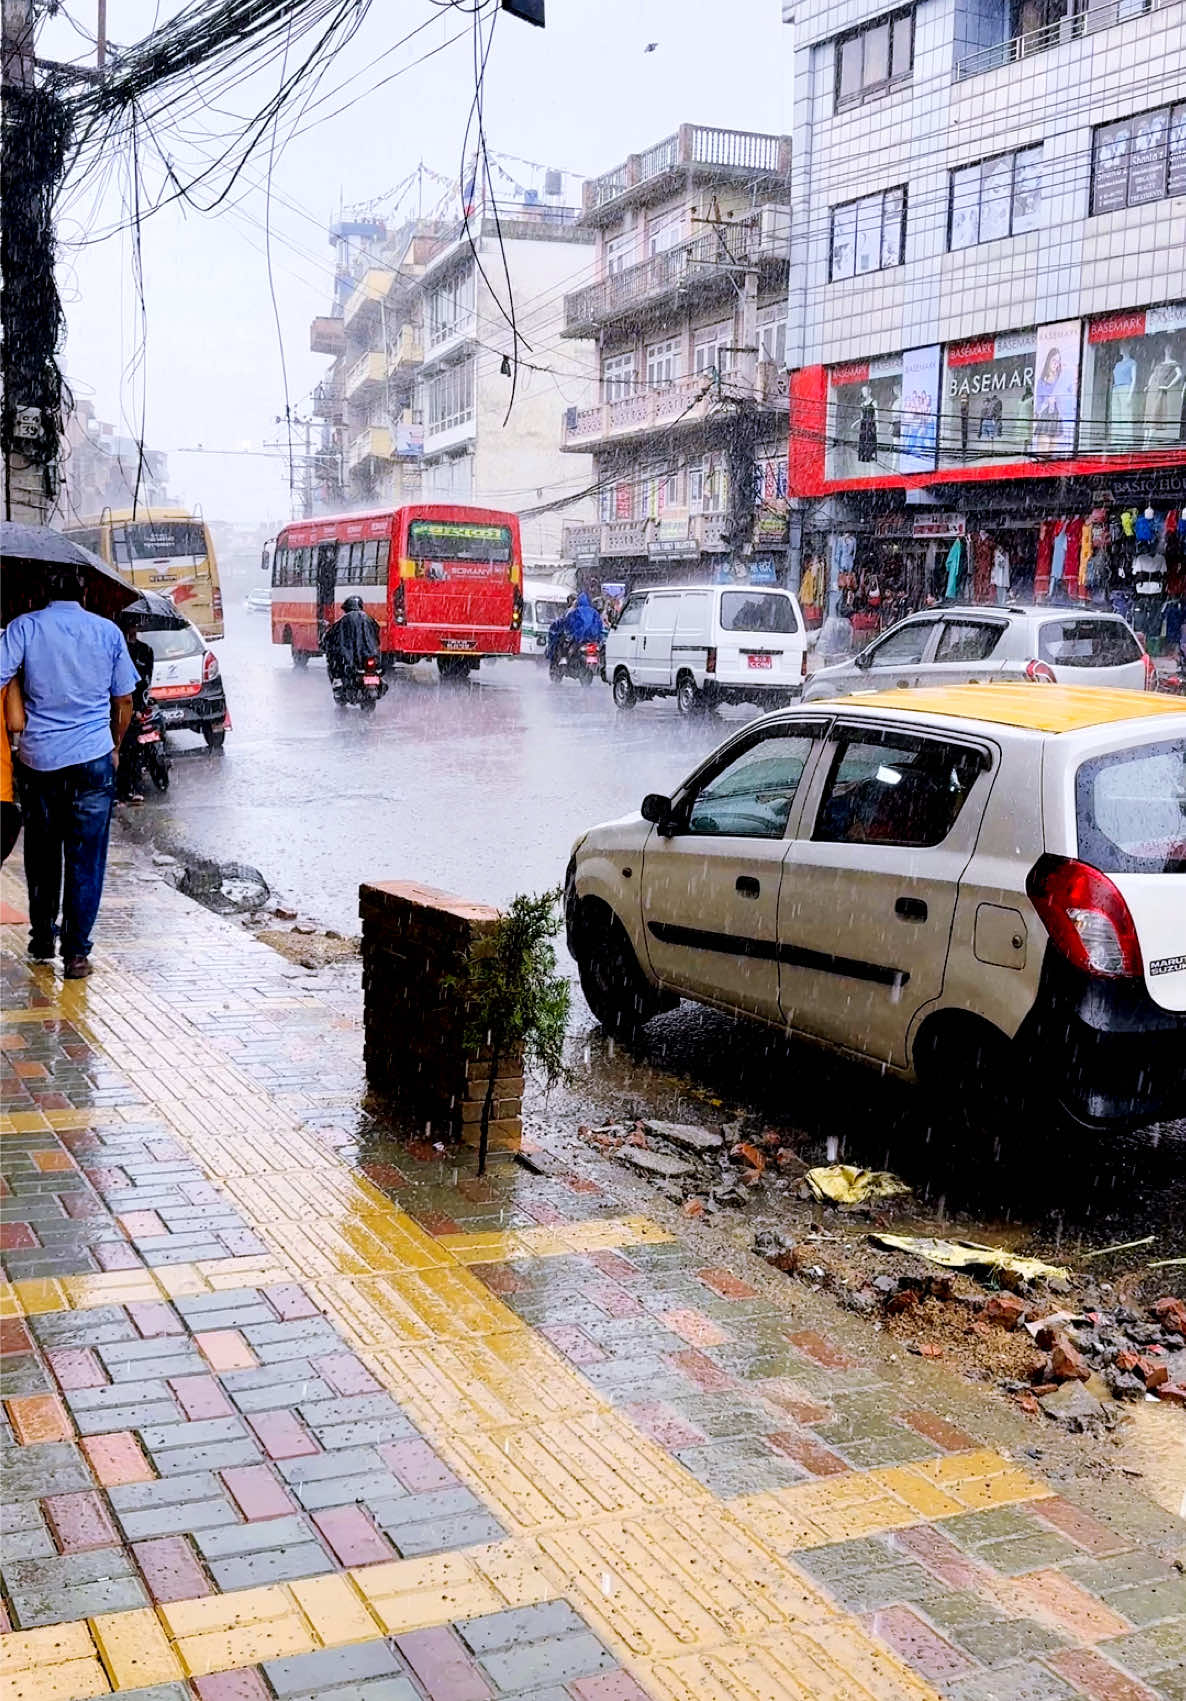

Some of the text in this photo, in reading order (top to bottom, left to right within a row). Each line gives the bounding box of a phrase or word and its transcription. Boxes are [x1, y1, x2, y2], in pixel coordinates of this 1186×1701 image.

[1091, 317, 1142, 335] BASEMARK
[950, 343, 992, 360] BASEMARK
[1113, 480, 1157, 493] BASIC
